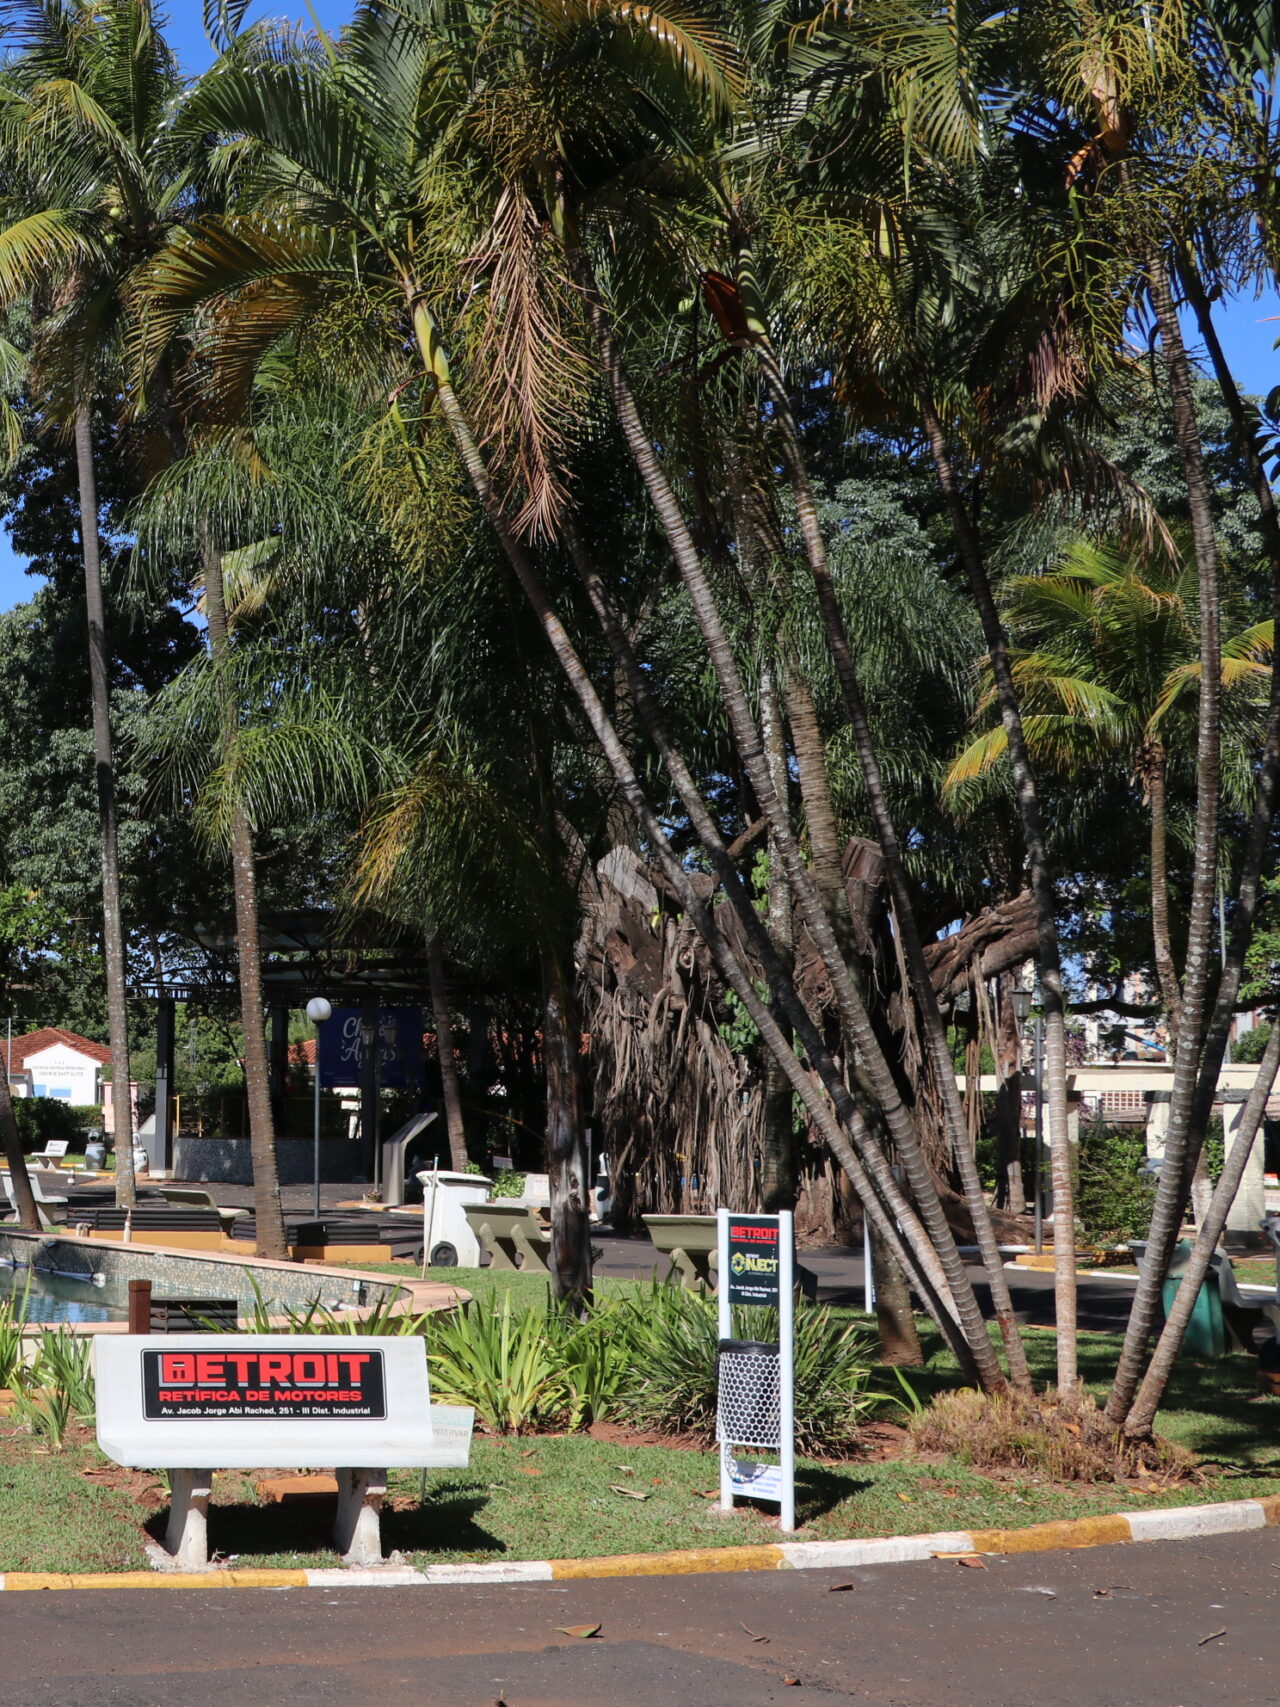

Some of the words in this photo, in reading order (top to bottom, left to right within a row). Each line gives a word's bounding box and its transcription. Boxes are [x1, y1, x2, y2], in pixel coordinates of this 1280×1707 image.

[159, 1389, 241, 1402] RETÍFICA
[245, 1390, 270, 1402] DE
[274, 1390, 363, 1402] MOTORES
[161, 1406, 175, 1415] Av.
[176, 1406, 202, 1415] Jacob
[203, 1406, 227, 1416] Jorge
[228, 1406, 243, 1415] Abi
[278, 1406, 294, 1415] 251
[311, 1406, 331, 1415] Dist.
[332, 1406, 371, 1415] Industrial
[432, 1427, 469, 1437] NSERVAR
